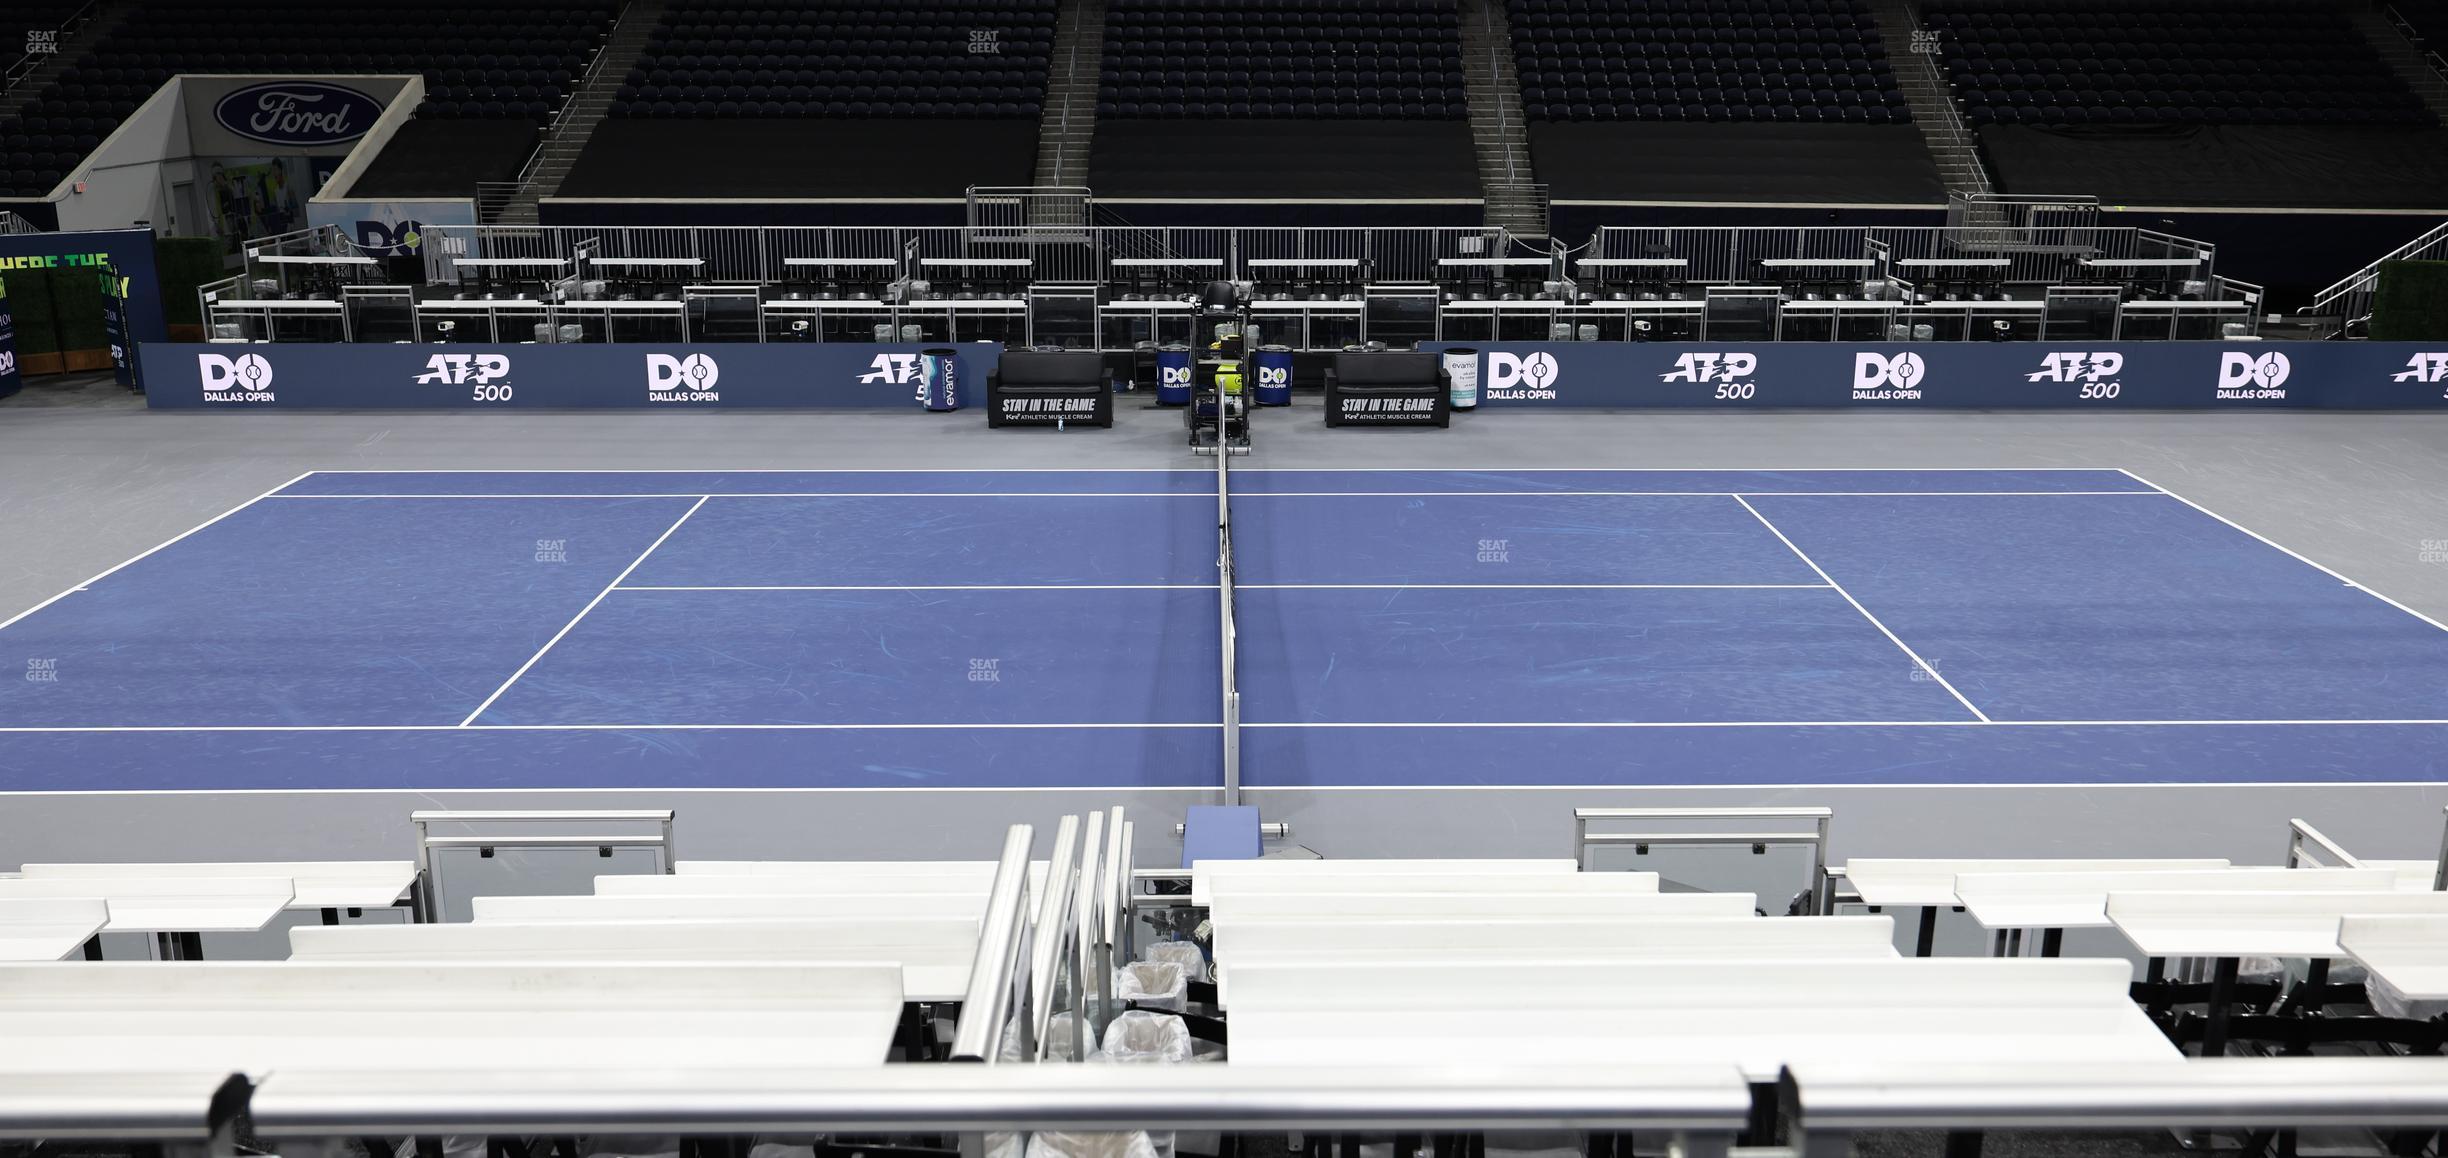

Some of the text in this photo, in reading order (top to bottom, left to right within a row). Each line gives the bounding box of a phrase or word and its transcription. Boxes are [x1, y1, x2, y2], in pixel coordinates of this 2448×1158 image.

[250, 91, 351, 134] Ford
[411, 354, 510, 384] ATP
[856, 354, 923, 384] AT
[1657, 352, 1757, 382] ATP
[2024, 352, 2124, 382] ATP
[2389, 353, 2448, 382] AT
[944, 359, 955, 406] evamor
[2079, 383, 2120, 398] 500
[204, 392, 275, 402] DALLAS OPEN
[473, 385, 513, 401] 500
[649, 392, 719, 401] DALLAS OPEN
[1487, 390, 1525, 400] DALLAS
[1527, 390, 1556, 400] OPEN
[1714, 383, 1755, 399] 500
[1852, 390, 1921, 399] DALLAS OPEN
[2216, 389, 2285, 399] DALLAS OPEN
[1002, 398, 1096, 412] STAY IN THE GAME
[1341, 398, 1435, 411] STAY IN THE GAME
